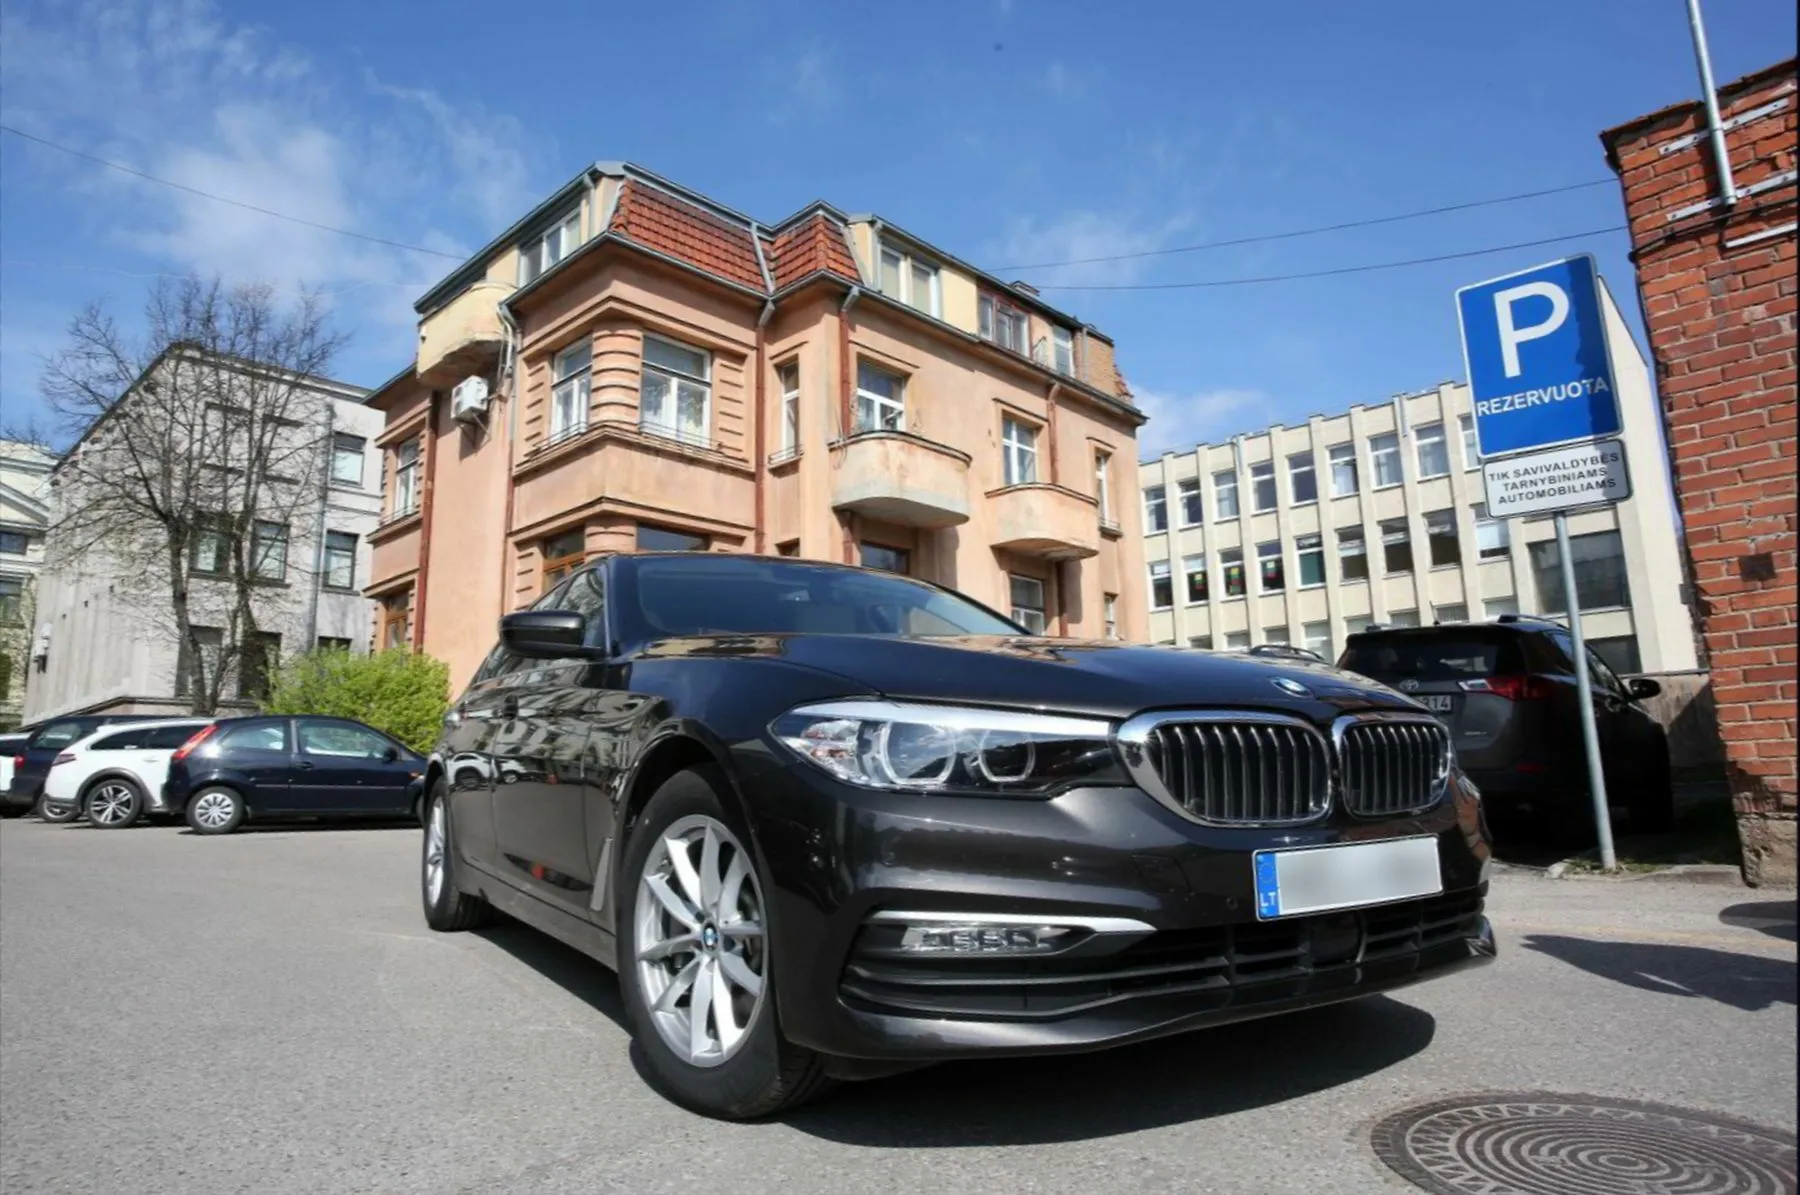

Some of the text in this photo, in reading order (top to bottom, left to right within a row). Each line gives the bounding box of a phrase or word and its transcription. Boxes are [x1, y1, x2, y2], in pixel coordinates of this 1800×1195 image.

[1494, 281, 1569, 378] P
[1476, 375, 1610, 417] REZERVUOTA
[1489, 470, 1510, 482] TIK
[1502, 467, 1607, 492] TARNYBINIAMS
[1498, 478, 1617, 504] AUTOMOBILIAMS
[1260, 891, 1276, 907] LT
